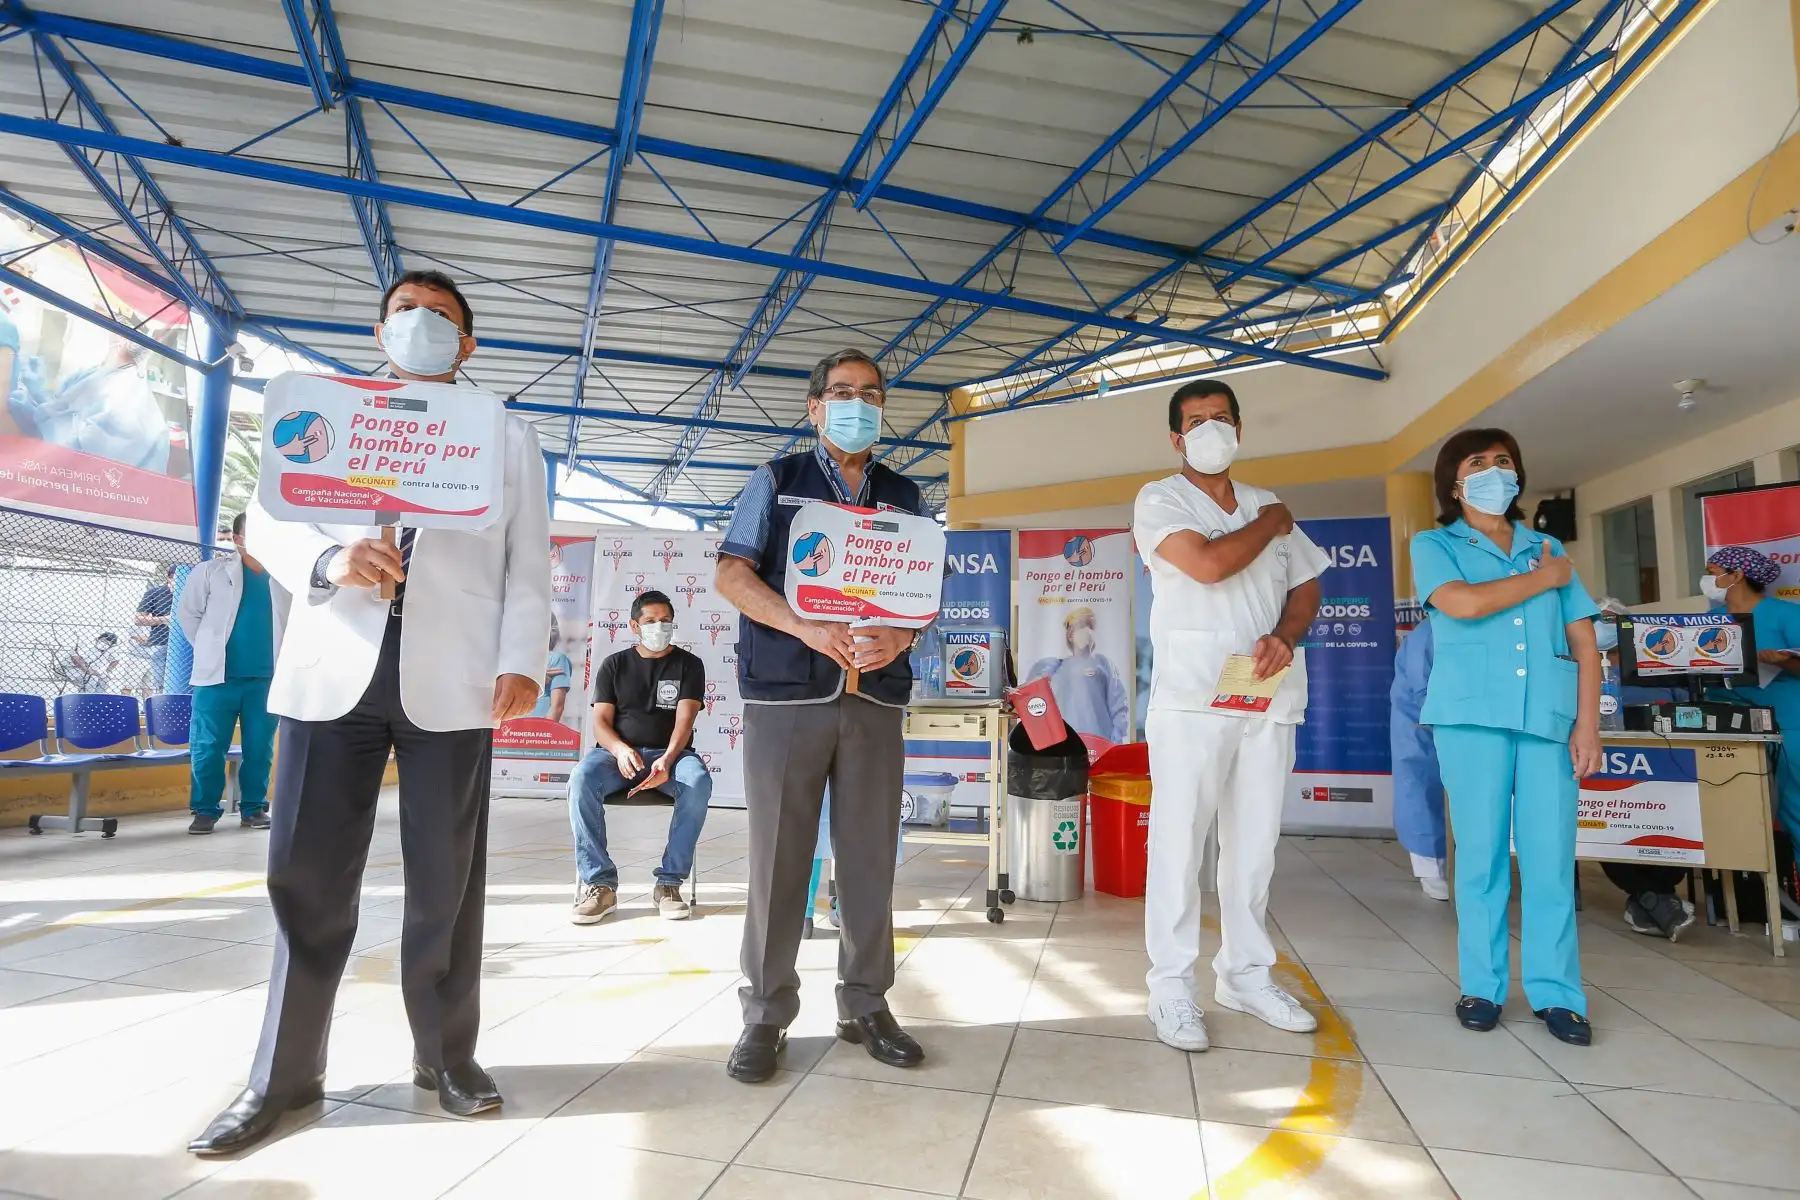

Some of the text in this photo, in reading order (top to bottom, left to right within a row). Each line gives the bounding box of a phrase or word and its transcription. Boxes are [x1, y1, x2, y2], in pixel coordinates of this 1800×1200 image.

[350, 413, 447, 437] Pongo el
[348, 432, 480, 461] hombro por
[348, 454, 427, 475] el Perú
[402, 480, 430, 489] contra
[431, 480, 440, 489] la
[441, 482, 480, 491] COVID-19
[292, 487, 370, 499] Campaña Nacional
[305, 495, 367, 506] de Vacunación
[845, 533, 911, 554] Pongo el
[603, 549, 633, 559] Loayza
[653, 549, 684, 559] Loayza
[704, 550, 722, 560] Loa
[843, 551, 934, 574] hombro por
[948, 553, 999, 574] NSA
[553, 573, 587, 583] ombro
[842, 569, 897, 586] el Perú
[1026, 569, 1124, 584] Pongo el hombro
[552, 583, 571, 593] erú
[625, 584, 654, 593] Loayza
[675, 585, 706, 595] Loayza
[1042, 581, 1106, 595] por el Perú
[906, 591, 932, 599] COVID-19
[804, 597, 858, 607] Campaña Nacional
[942, 600, 956, 608] LUD
[822, 604, 855, 612] Vacunación
[942, 607, 990, 619] TODOS
[1683, 615, 1732, 626] MINSA
[598, 621, 628, 631] Loayza
[699, 623, 731, 633] Loayza
[949, 634, 988, 644] MINSA
[703, 693, 727, 703] oayza
[509, 730, 535, 738] PRIMERA
[718, 726, 744, 736] Loayz
[1578, 799, 1666, 810] ongo el hombro
[1591, 809, 1602, 818] el
[1604, 810, 1631, 819] Perú
